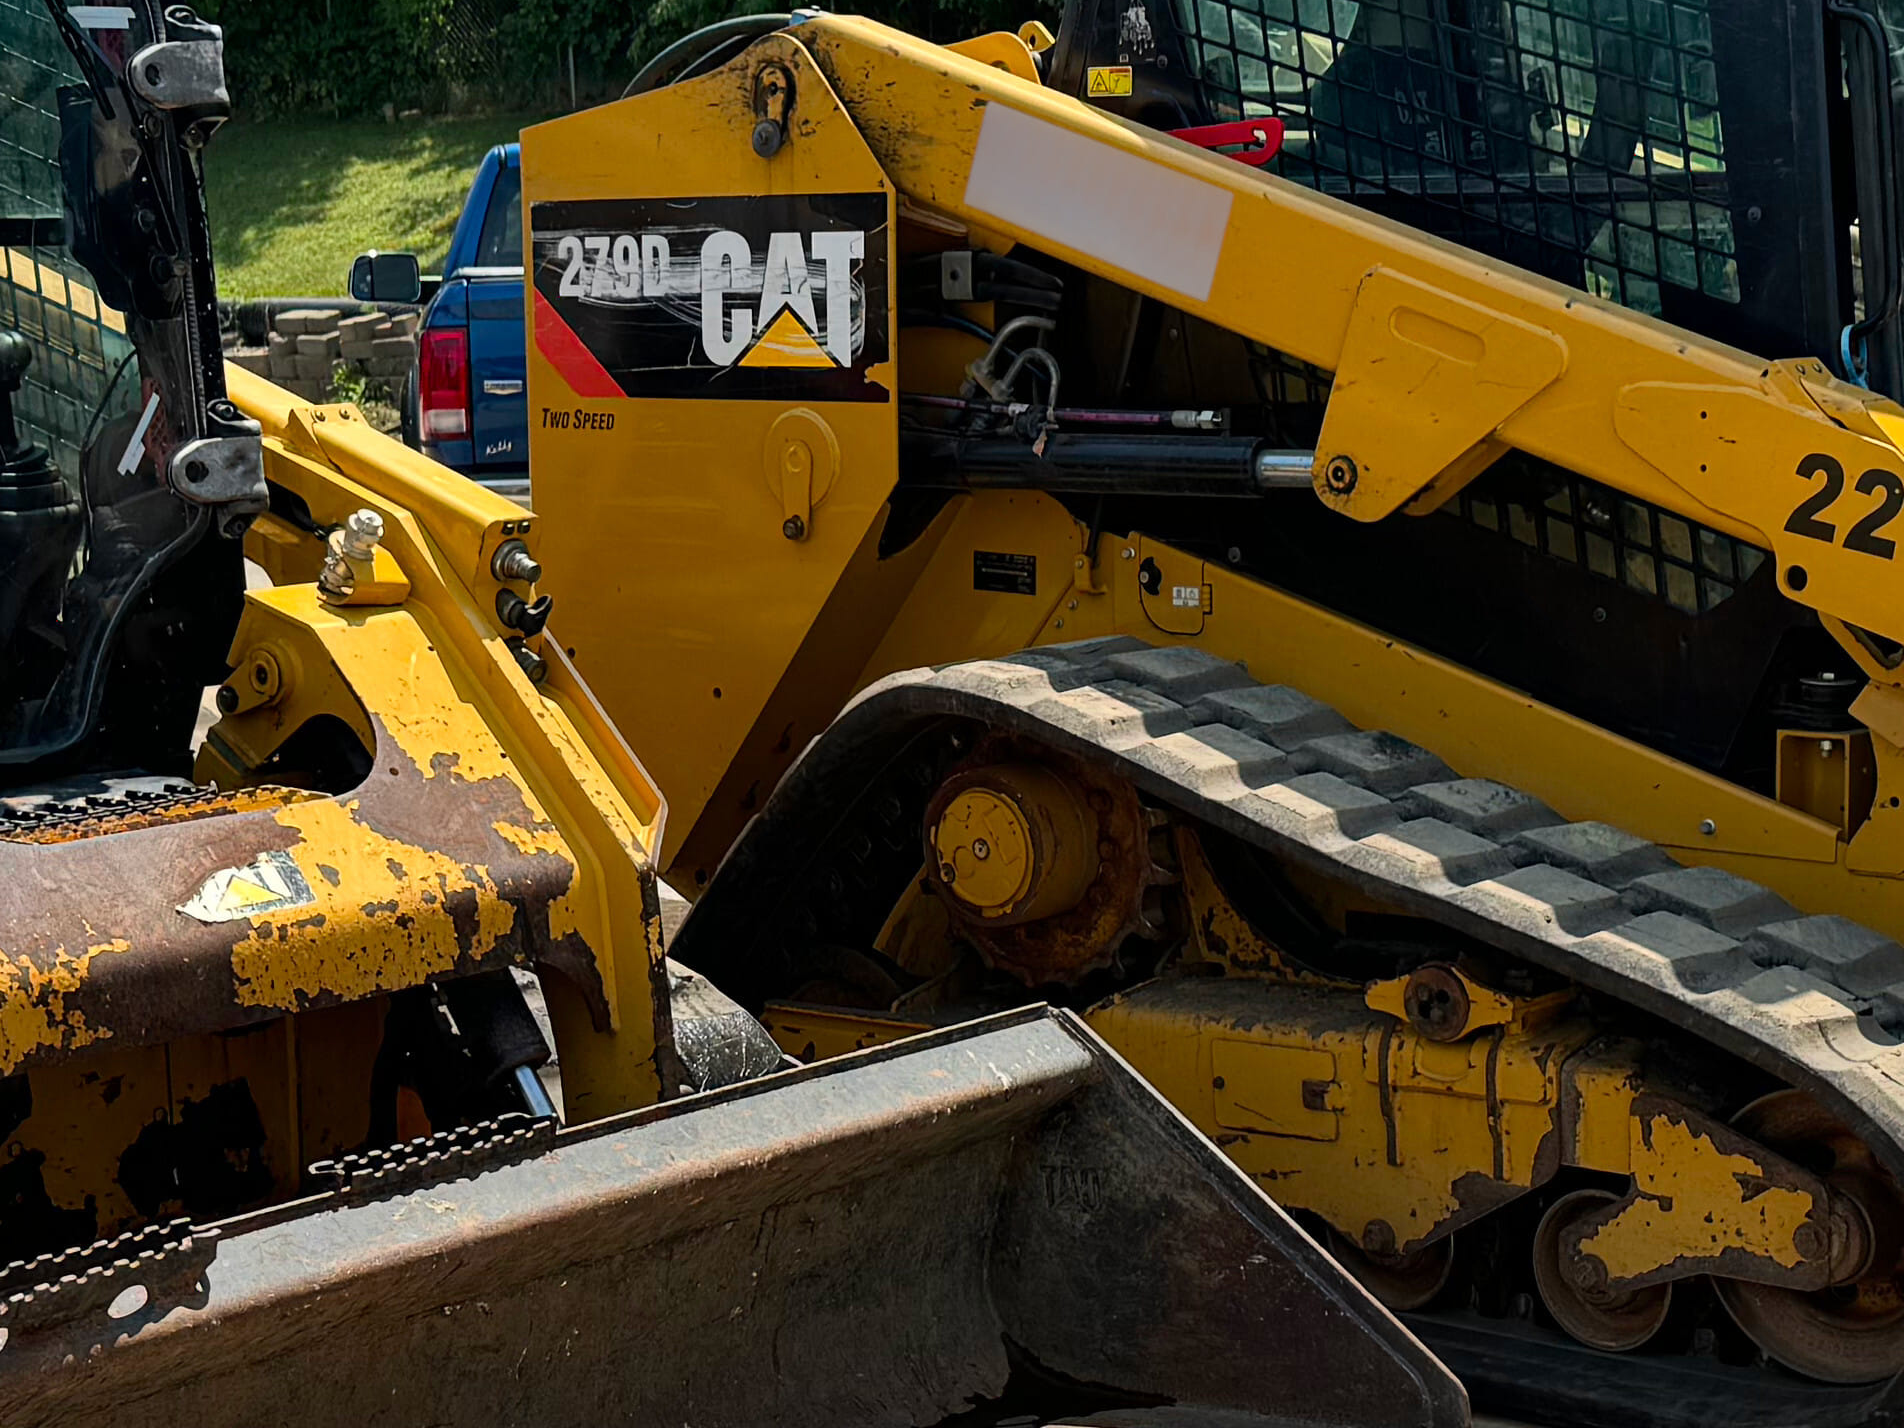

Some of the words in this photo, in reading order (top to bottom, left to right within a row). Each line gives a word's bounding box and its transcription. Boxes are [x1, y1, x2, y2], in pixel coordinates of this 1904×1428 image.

[558, 235, 671, 297] 279D
[700, 230, 865, 368] CAT
[1784, 453, 1904, 561] 22
